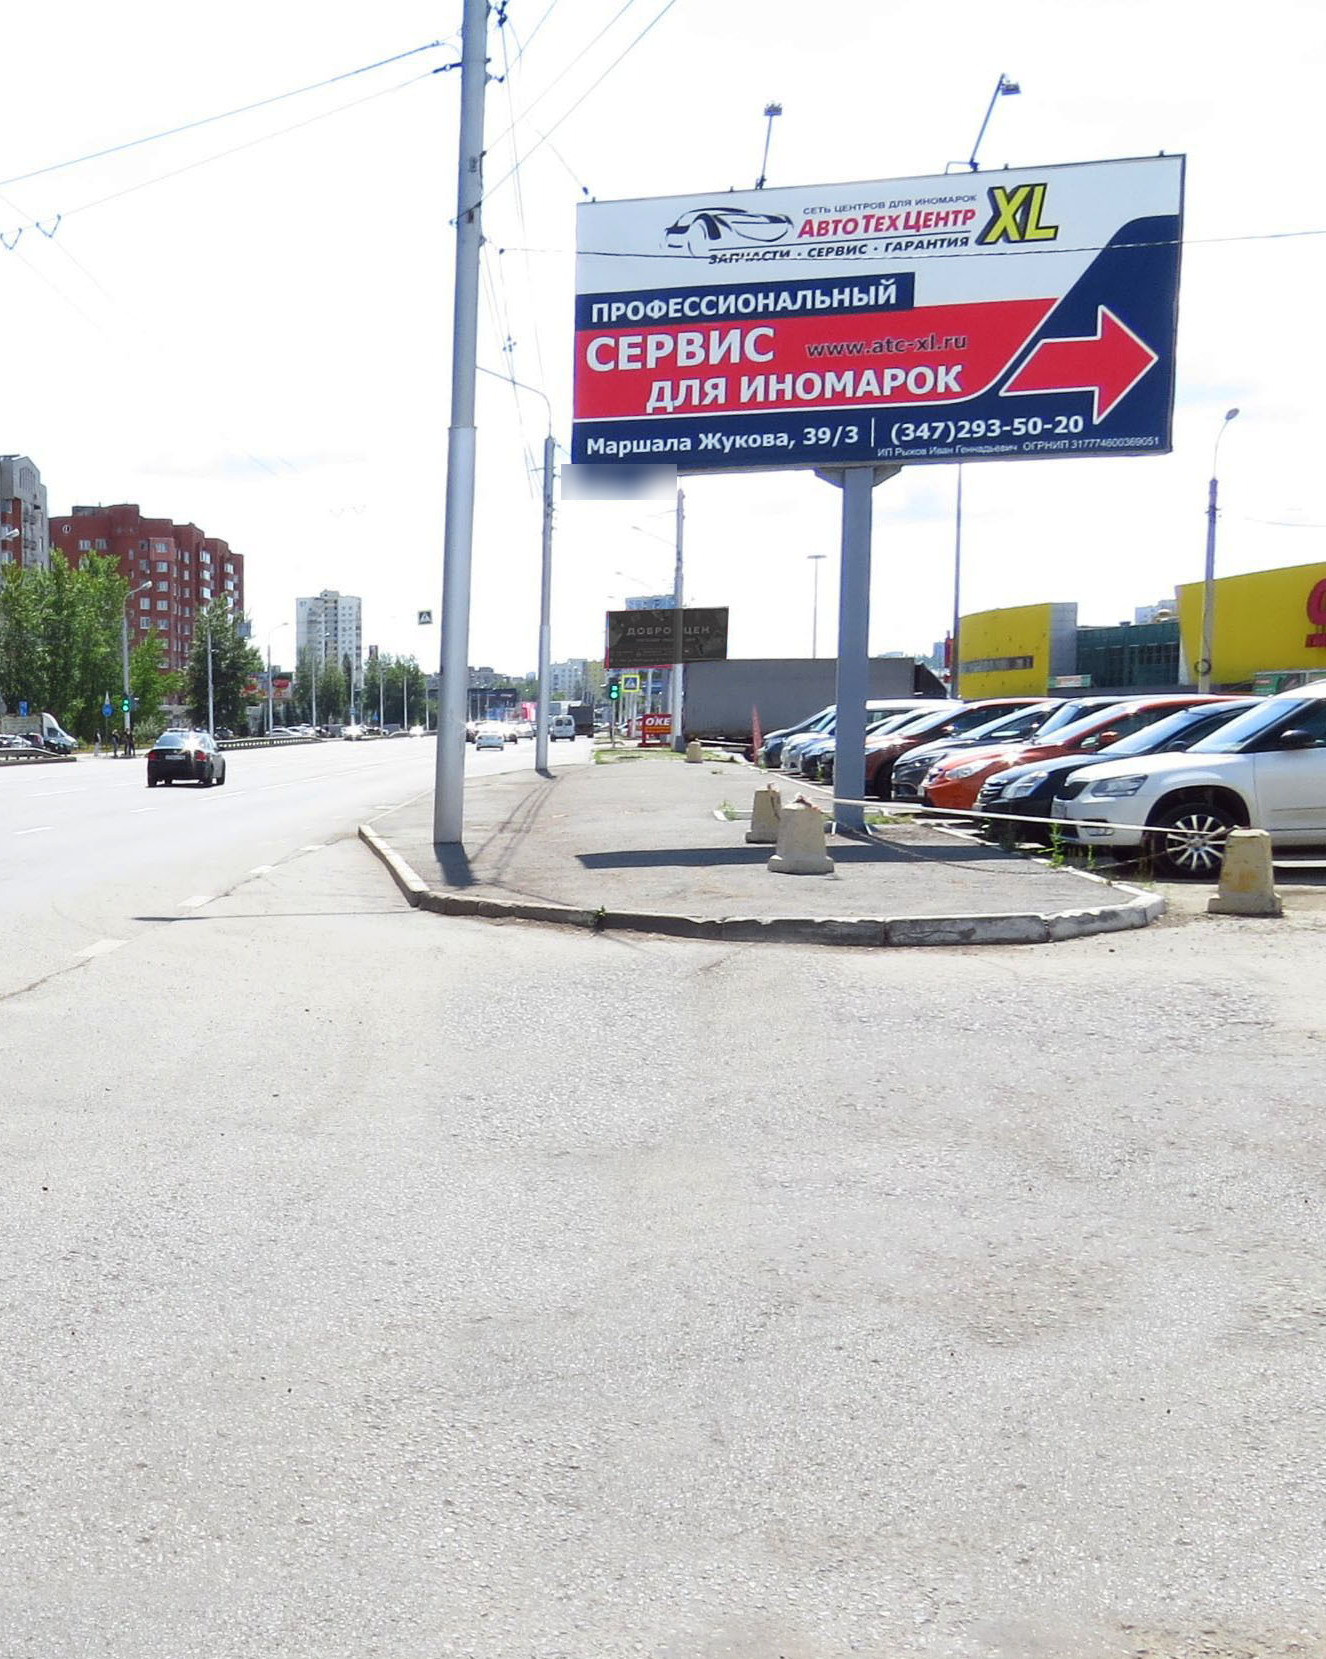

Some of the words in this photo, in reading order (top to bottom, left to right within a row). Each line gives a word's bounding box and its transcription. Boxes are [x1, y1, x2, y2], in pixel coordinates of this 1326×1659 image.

[802, 206, 831, 216] СЕТЬ
[834, 201, 886, 214] ЦЕНТРОВ
[888, 199, 913, 210] ДЛЯ
[915, 194, 978, 207] ИНОМАРОК
[975, 183, 1060, 245] XL
[806, 243, 868, 258] СЕРВИС
[883, 236, 970, 254] ГАРАНТИЯ
[591, 278, 898, 323] ПРОФЕССИОНАЛЬНЫЙ
[586, 326, 776, 374] СЕРВИС
[806, 333, 968, 360] www.atc-xl.ru
[645, 376, 727, 414] ДЛЯ
[739, 363, 964, 405] ИНОМАРОК
[586, 436, 692, 458] Маршала
[697, 430, 797, 454] Жукова,
[801, 425, 859, 448] 39/3
[890, 415, 1084, 445] (347)293-50-20
[928, 446, 953, 456] Иван
[1023, 439, 1069, 451] ОГРНИП
